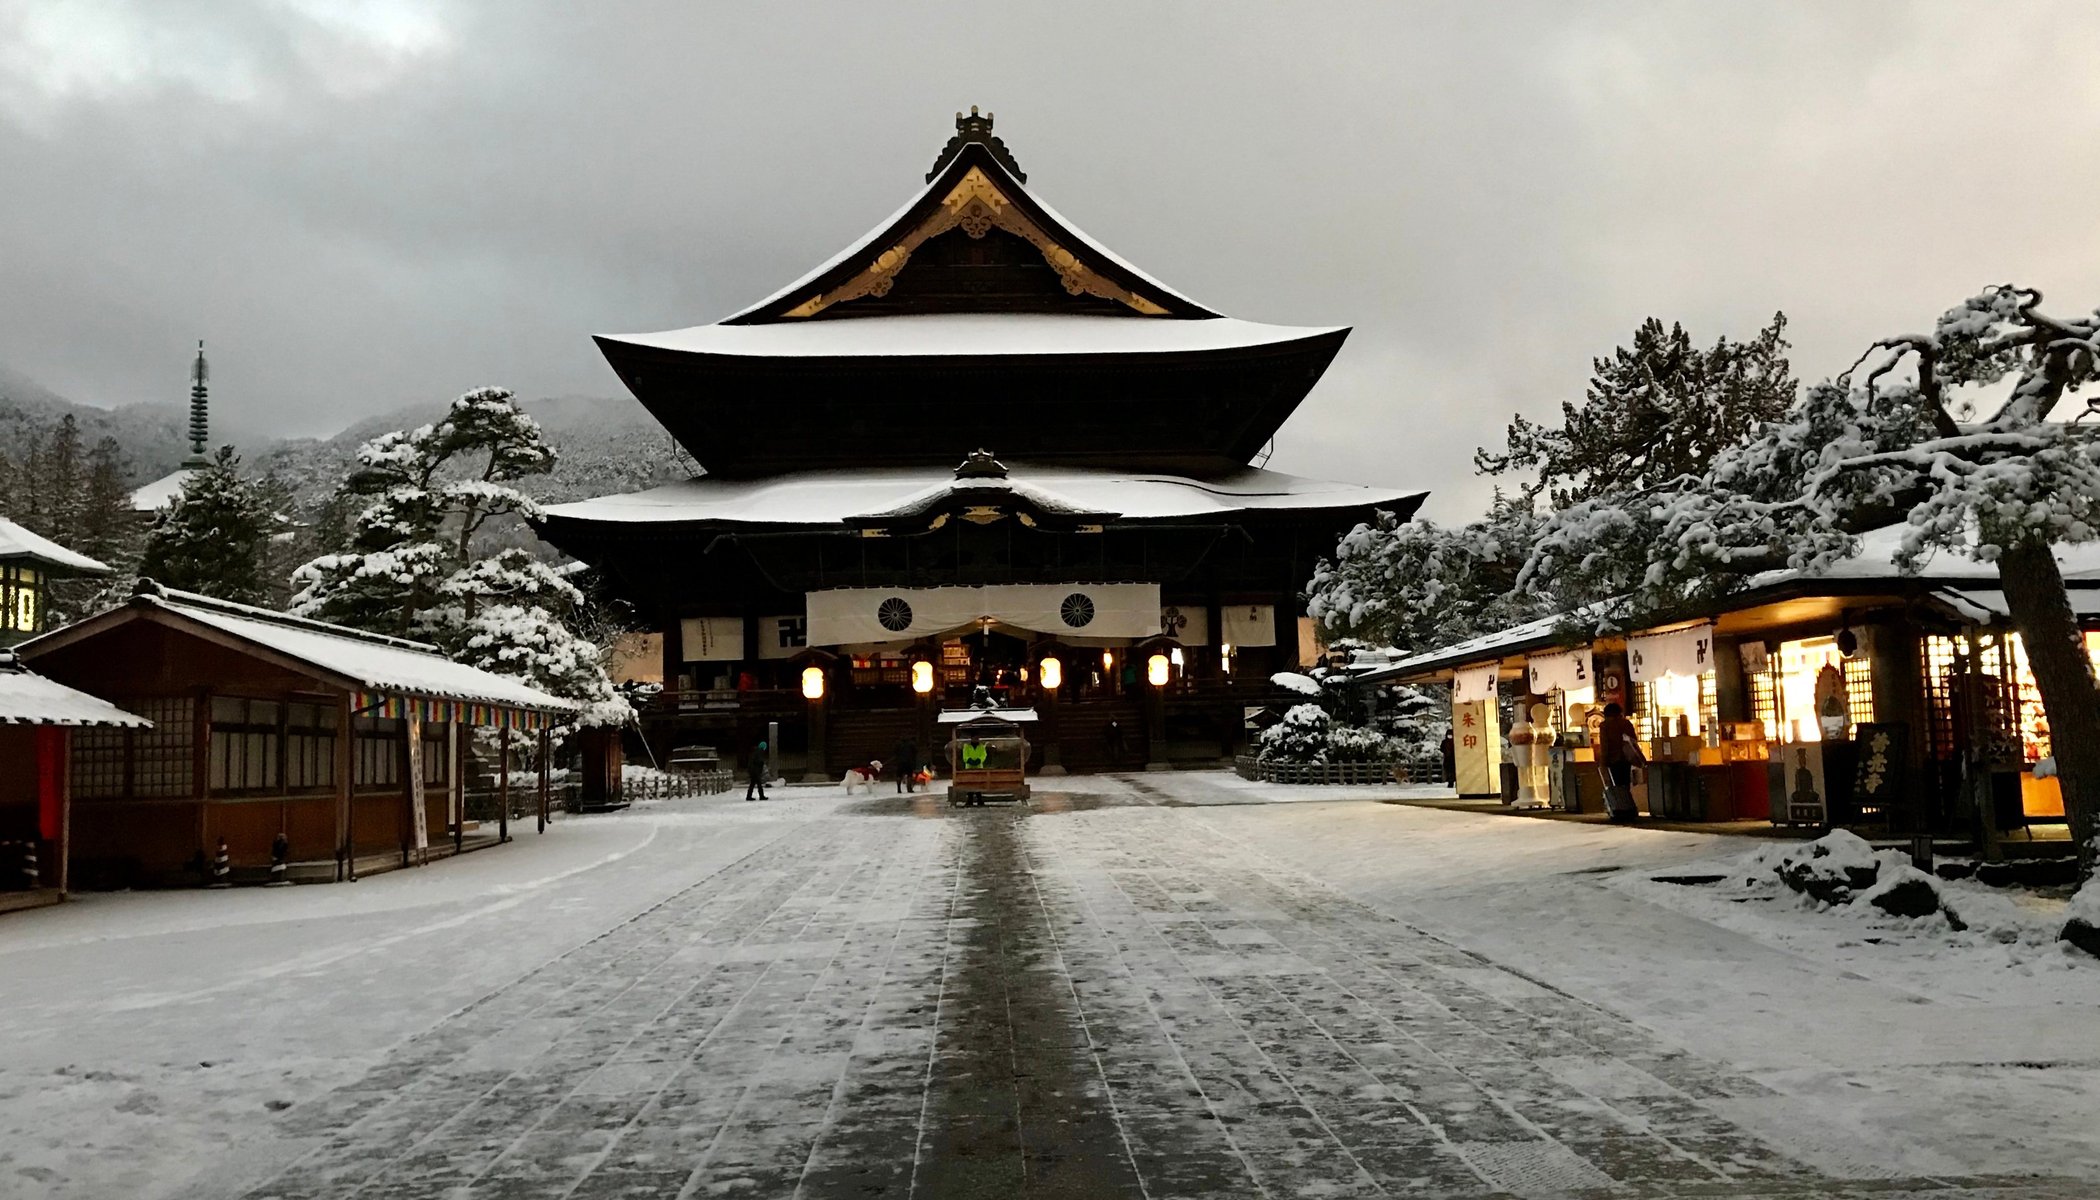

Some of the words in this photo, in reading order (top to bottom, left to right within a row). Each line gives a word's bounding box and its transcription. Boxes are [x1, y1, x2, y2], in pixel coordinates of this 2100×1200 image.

[1462, 702, 1477, 749] 朱印
[1864, 732, 1890, 794] 善光寺
